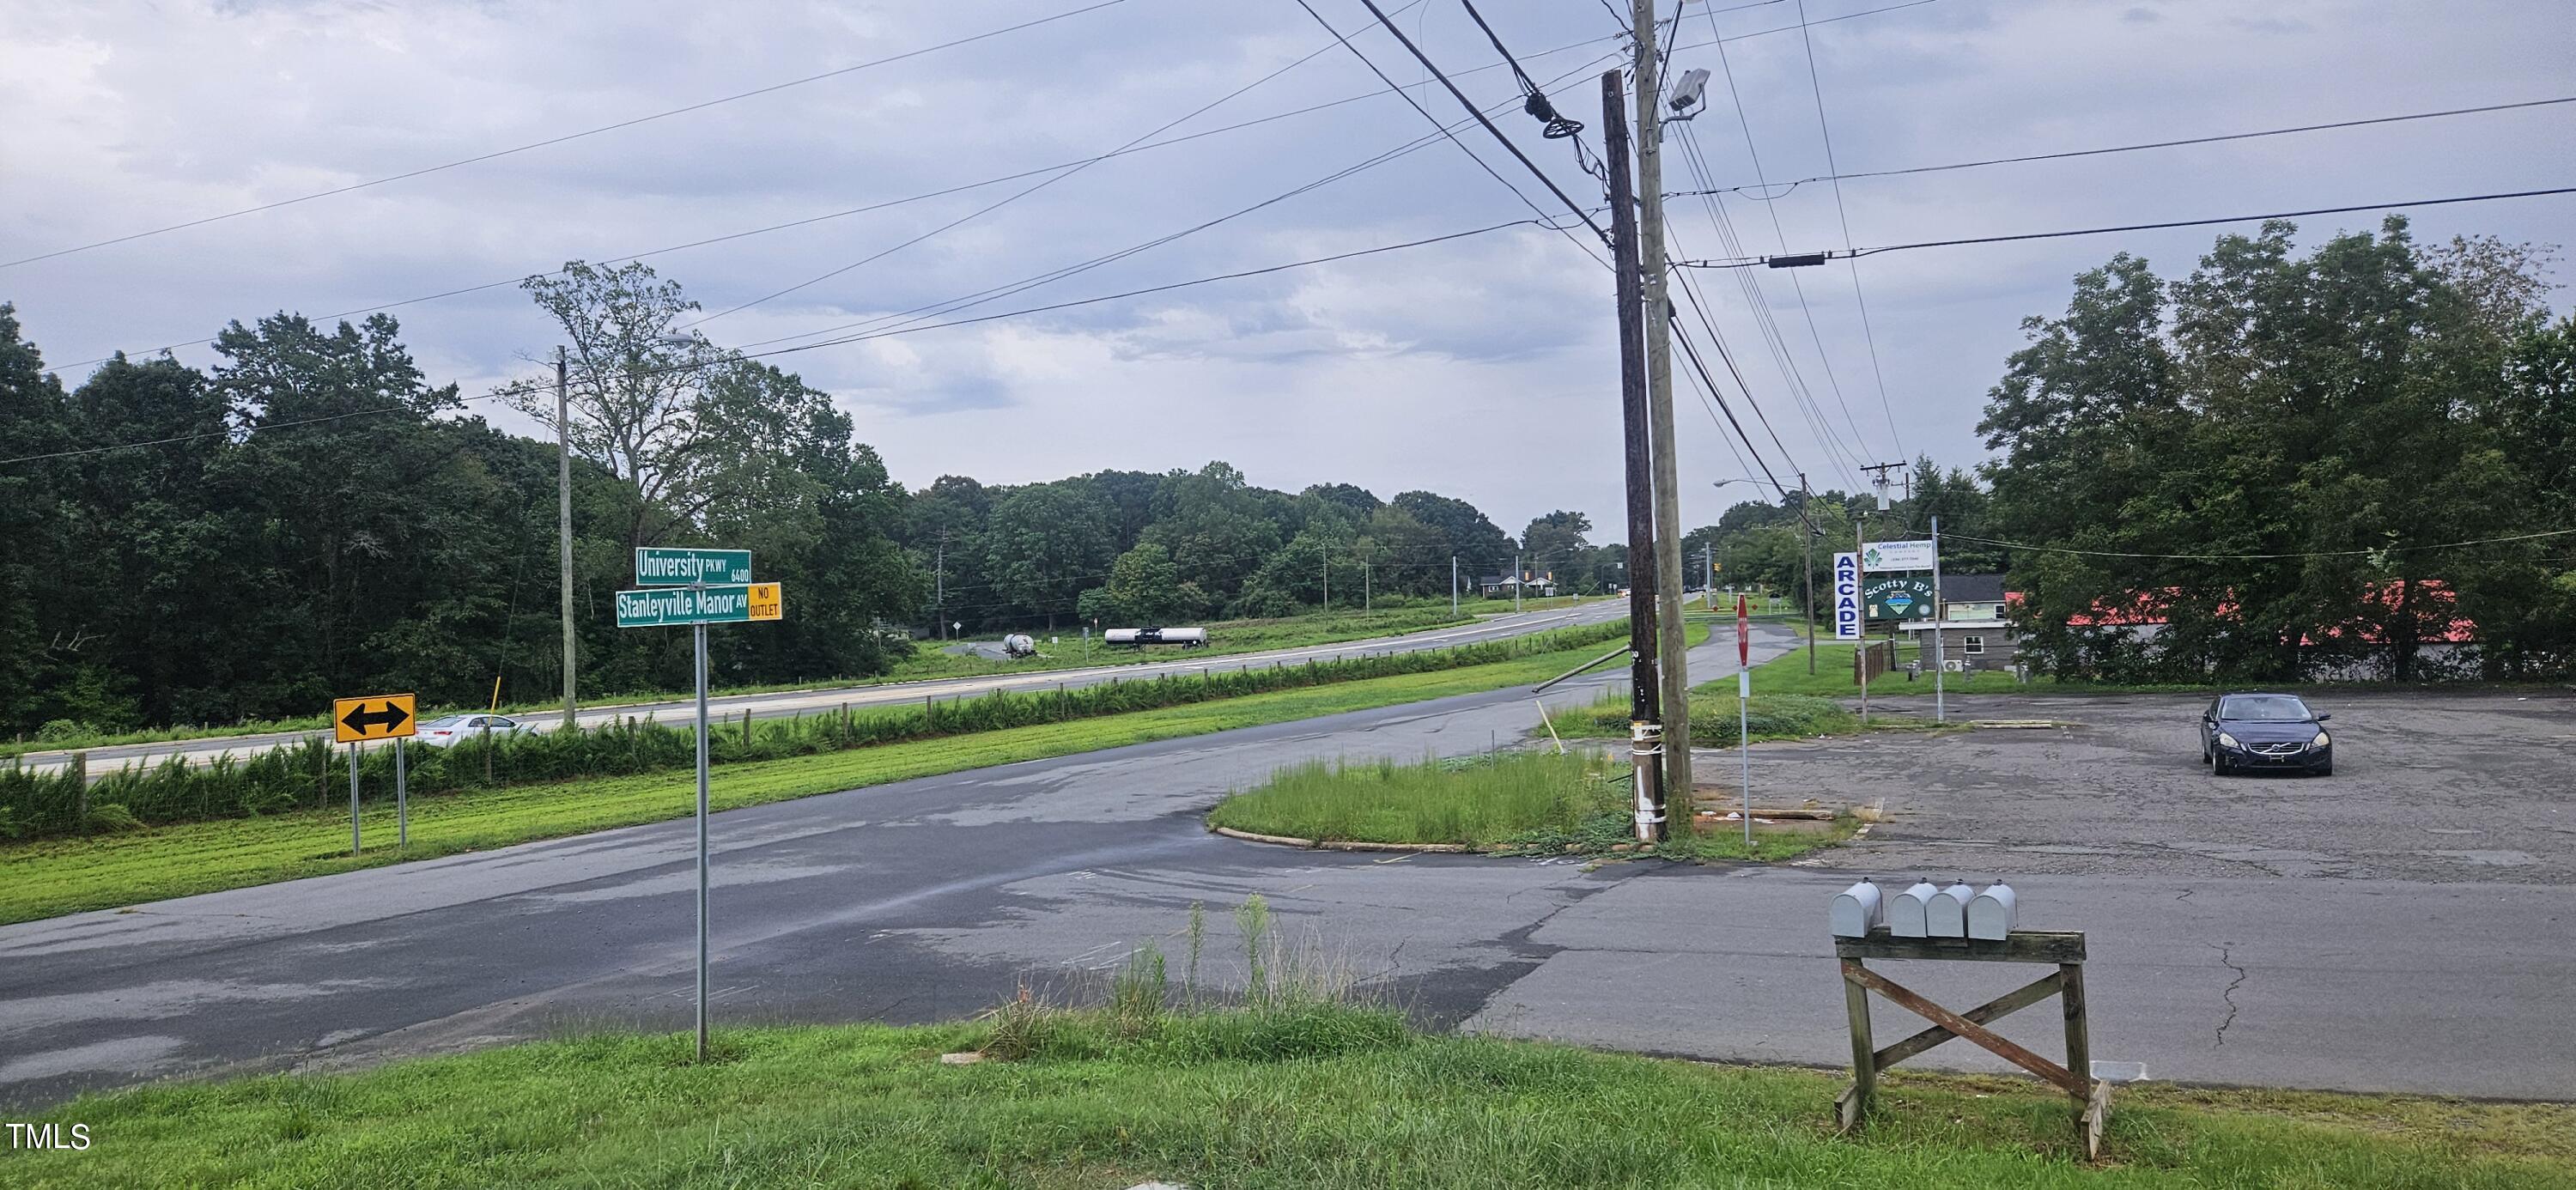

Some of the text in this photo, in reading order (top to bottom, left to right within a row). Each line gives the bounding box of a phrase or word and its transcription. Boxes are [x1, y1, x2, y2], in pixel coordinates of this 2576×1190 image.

[639, 550, 726, 582] University PKWY
[731, 568, 750, 582] 6400
[758, 587, 769, 599] NO
[1837, 556, 1856, 636] ARCADE
[1864, 580, 1933, 599] Scotty B's
[618, 591, 747, 622] Stanleyville Manor AV
[750, 604, 778, 616] OUTLET
